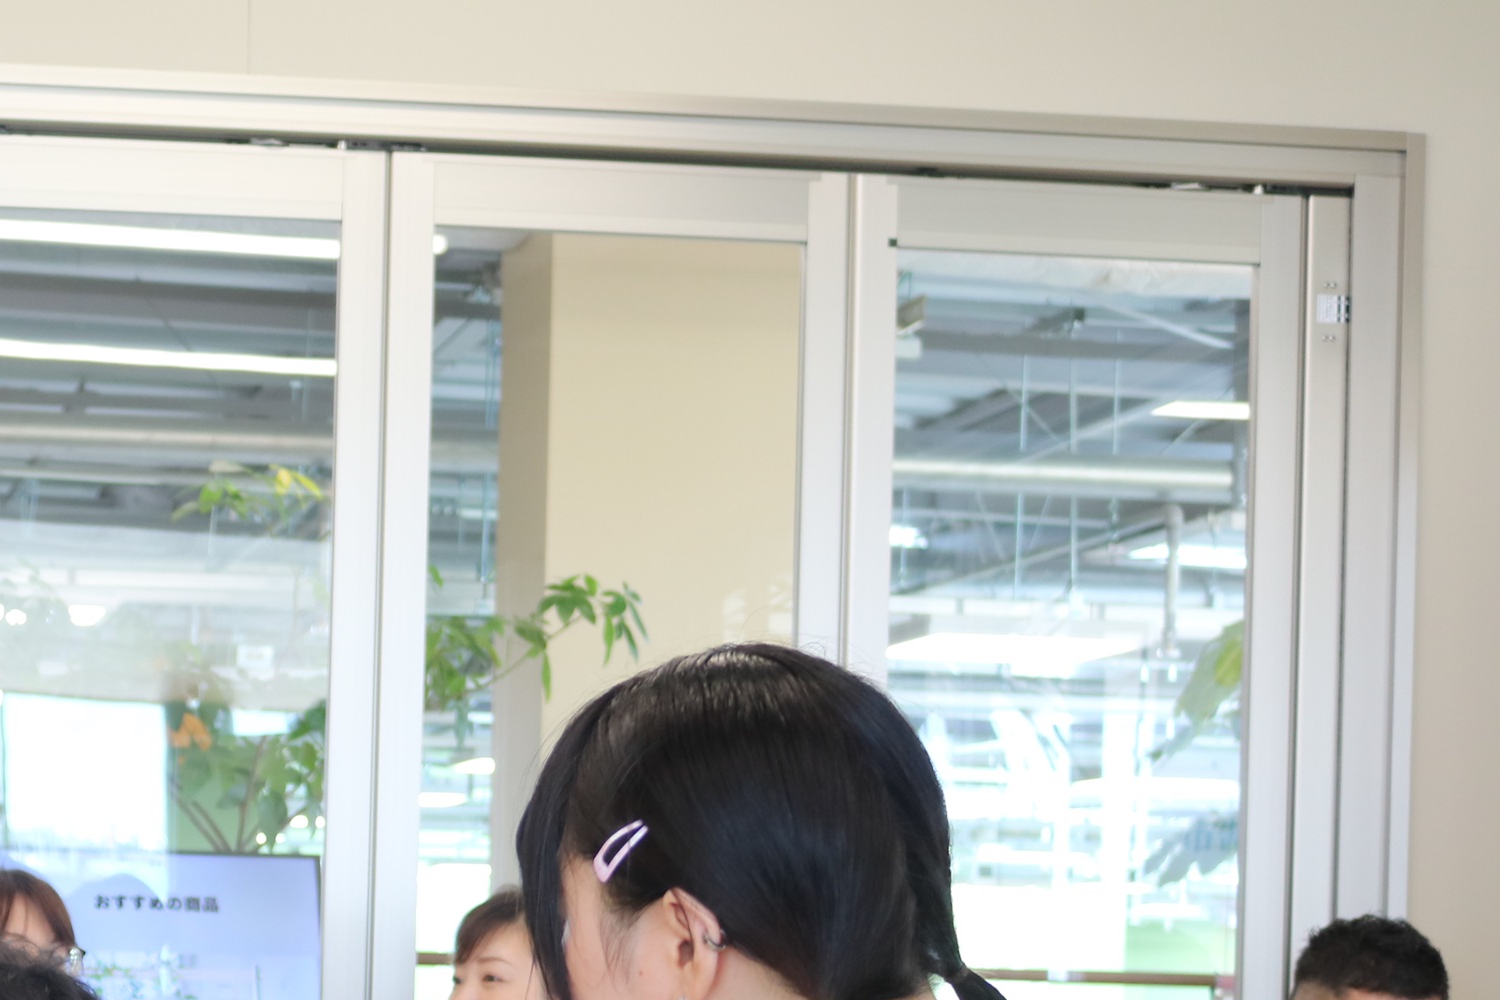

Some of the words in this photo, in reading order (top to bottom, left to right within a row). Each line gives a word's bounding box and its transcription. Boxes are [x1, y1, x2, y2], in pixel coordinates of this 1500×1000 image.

[94, 895, 219, 912] おすすめの商品
